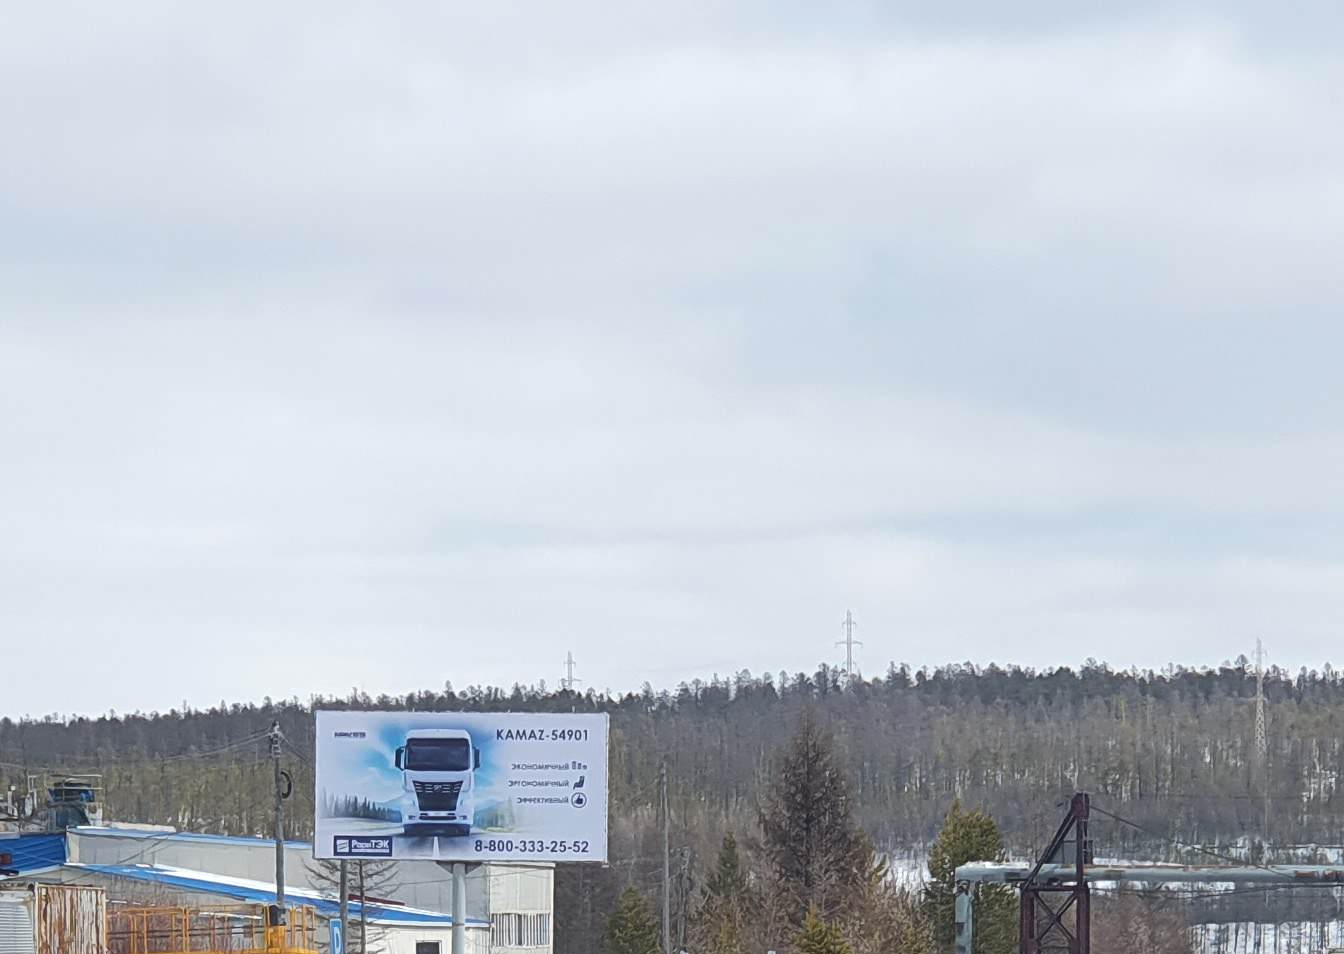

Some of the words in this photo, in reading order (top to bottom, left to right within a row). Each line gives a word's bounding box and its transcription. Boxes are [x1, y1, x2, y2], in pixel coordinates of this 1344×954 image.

[496, 729, 588, 741] KAMAZ-54901
[508, 779, 569, 787] ЭРГОНОМИЧНЫЙ
[474, 839, 589, 853] 8-800-333-25-52
